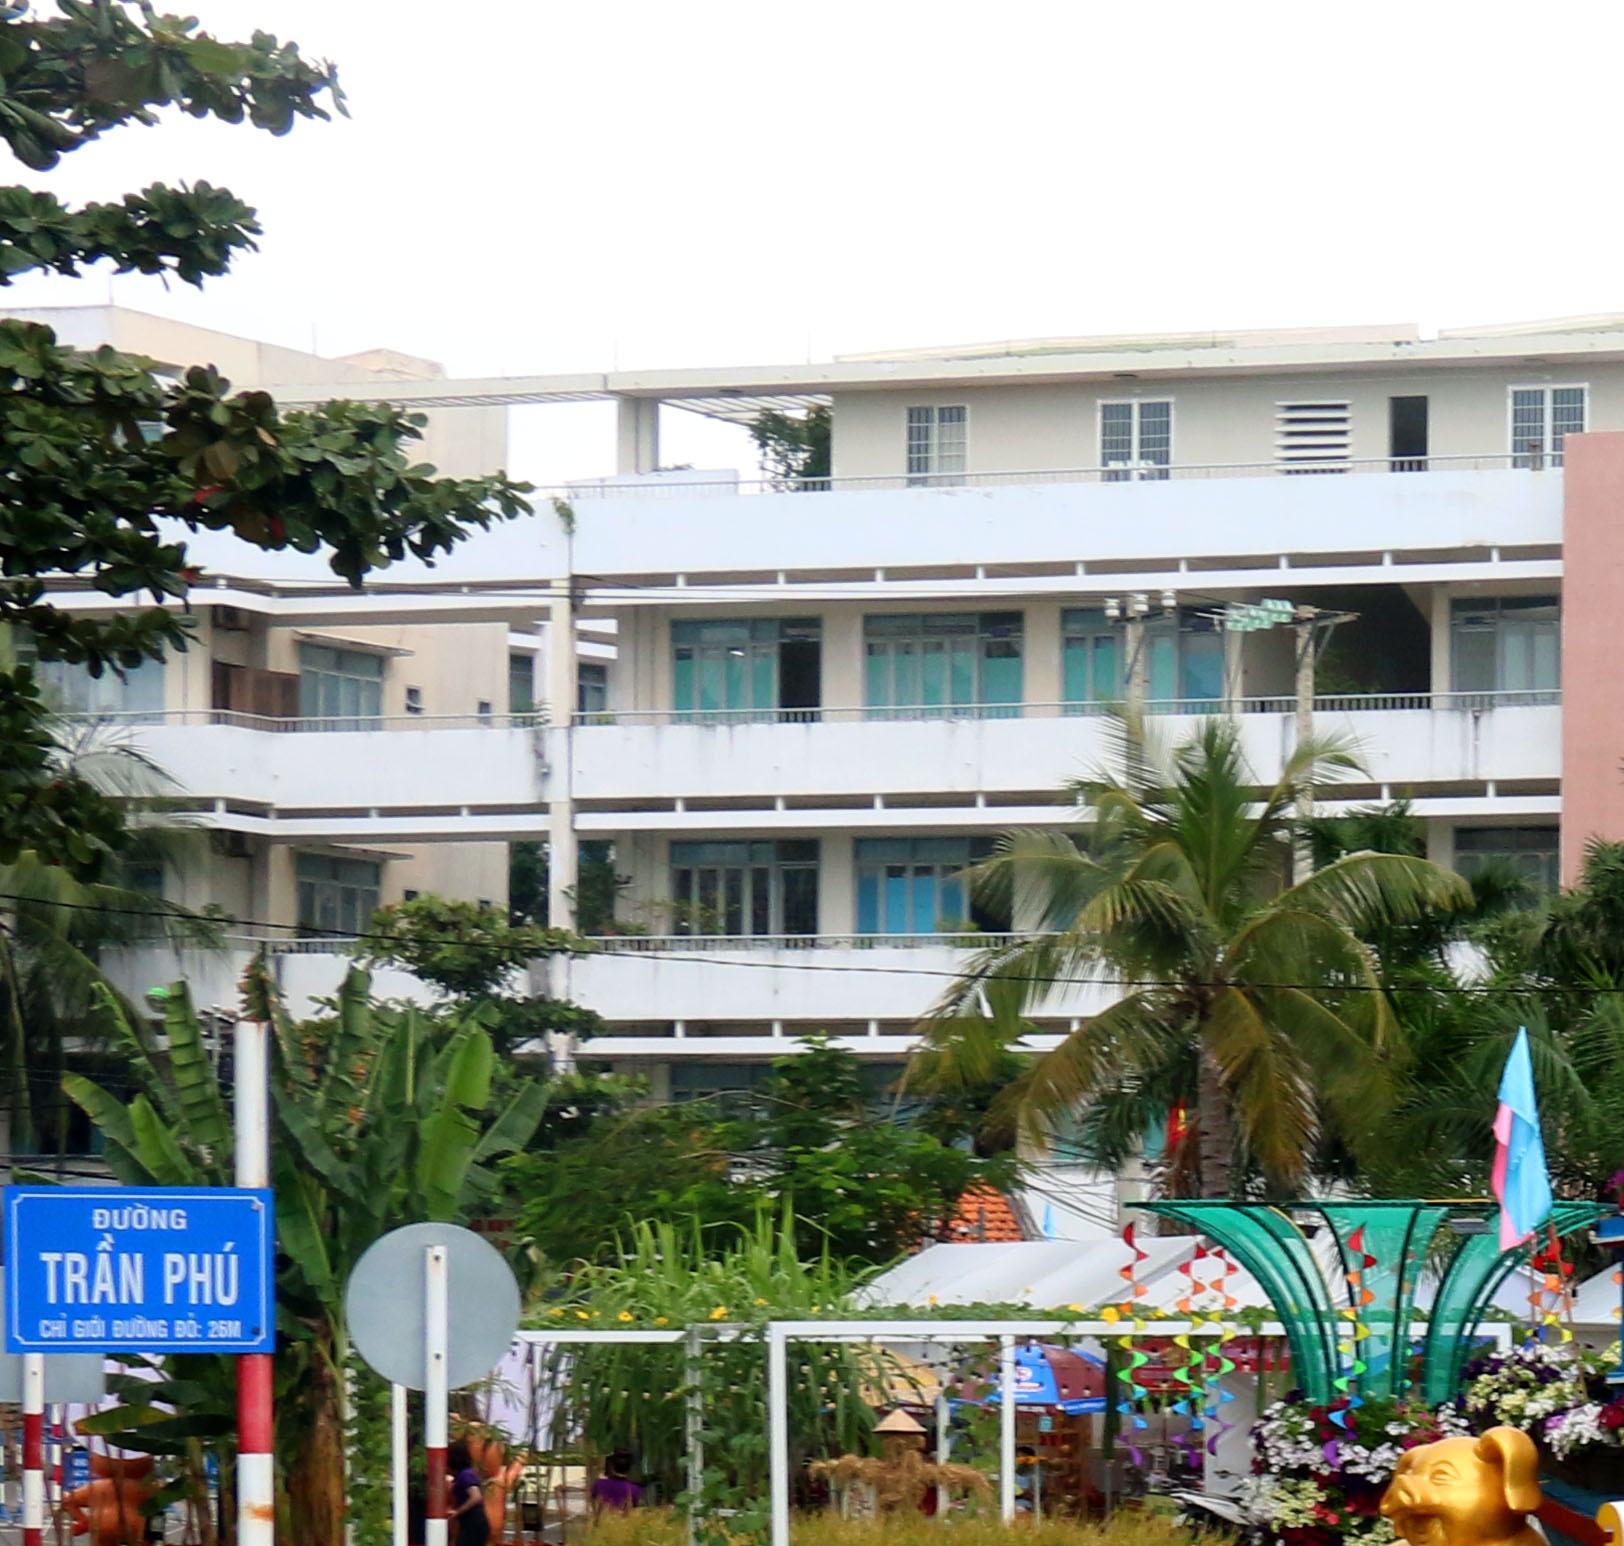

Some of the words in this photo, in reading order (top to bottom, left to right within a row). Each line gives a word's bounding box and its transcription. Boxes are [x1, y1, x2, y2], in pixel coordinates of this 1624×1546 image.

[92, 1203, 188, 1230] ĐƯỜNG
[39, 1232, 145, 1305] TRẦN
[163, 1241, 240, 1306] PHÚ
[39, 1312, 68, 1338] CHỈ
[72, 1314, 106, 1338] GIỚI
[112, 1314, 169, 1338] ĐƯỜNG
[174, 1312, 203, 1338] ĐỎ:
[207, 1319, 242, 1338] 26M
